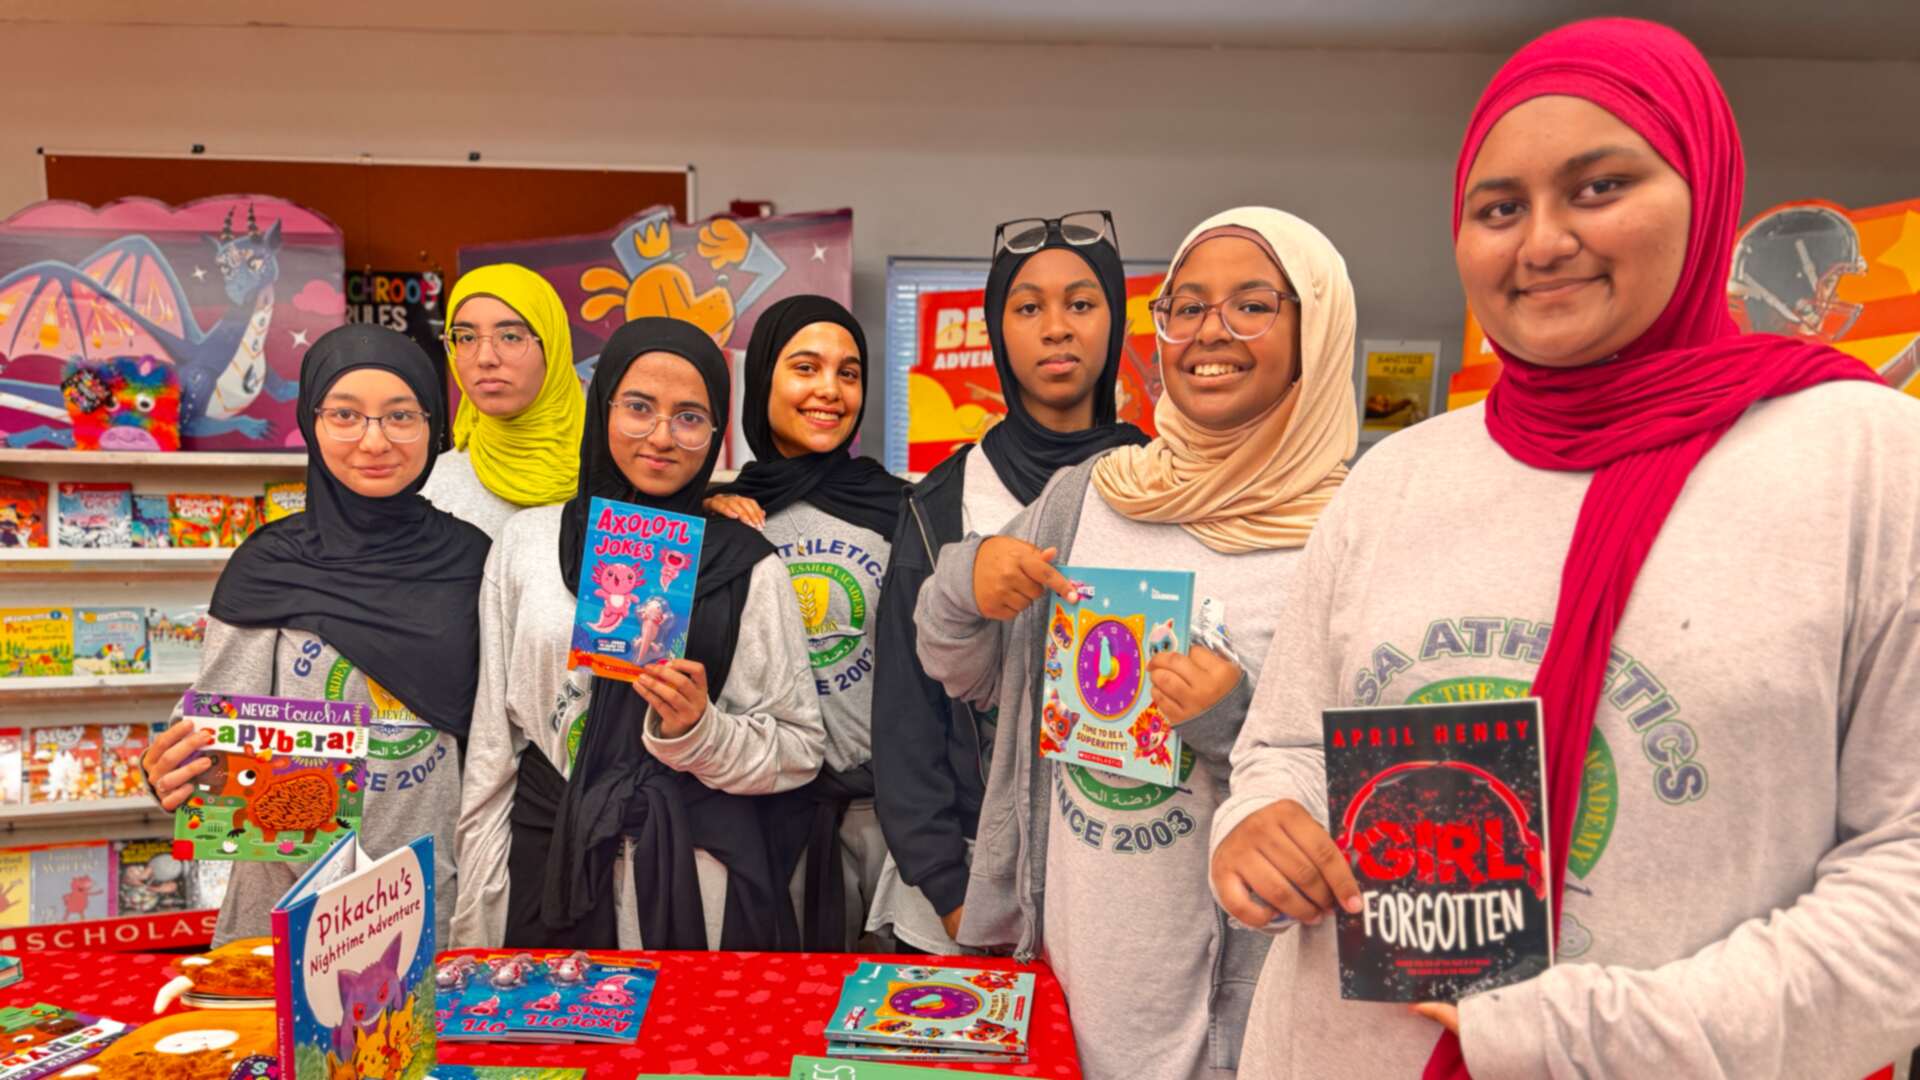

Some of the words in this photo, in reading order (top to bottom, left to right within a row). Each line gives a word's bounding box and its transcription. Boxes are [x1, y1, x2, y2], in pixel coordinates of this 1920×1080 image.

[597, 506, 691, 544] AXOLOTL
[595, 536, 654, 561] JOKES
[294, 640, 327, 677] GS
[241, 702, 280, 718] NEVER
[280, 701, 341, 724] touch
[343, 709, 351, 722] A
[1420, 618, 1706, 804] ATHTICS
[1076, 731, 1128, 751] SUPERKITTY!
[1082, 723, 1097, 736] TIME
[1098, 728, 1107, 737] TO
[1108, 730, 1117, 738] BE
[1331, 726, 1415, 748] APRIL
[1434, 719, 1530, 745] HENRY
[1056, 762, 1105, 847] INCE
[1112, 808, 1195, 852] 2003
[1353, 816, 1524, 885] GIRL
[317, 867, 412, 946] Pikachu's
[1362, 888, 1525, 952] FORGOTTEN
[310, 933, 365, 977] Nighttime
[367, 898, 421, 939] Adventure
[523, 1012, 633, 1033] AXOLOTL
[567, 1003, 634, 1020] JOKES
